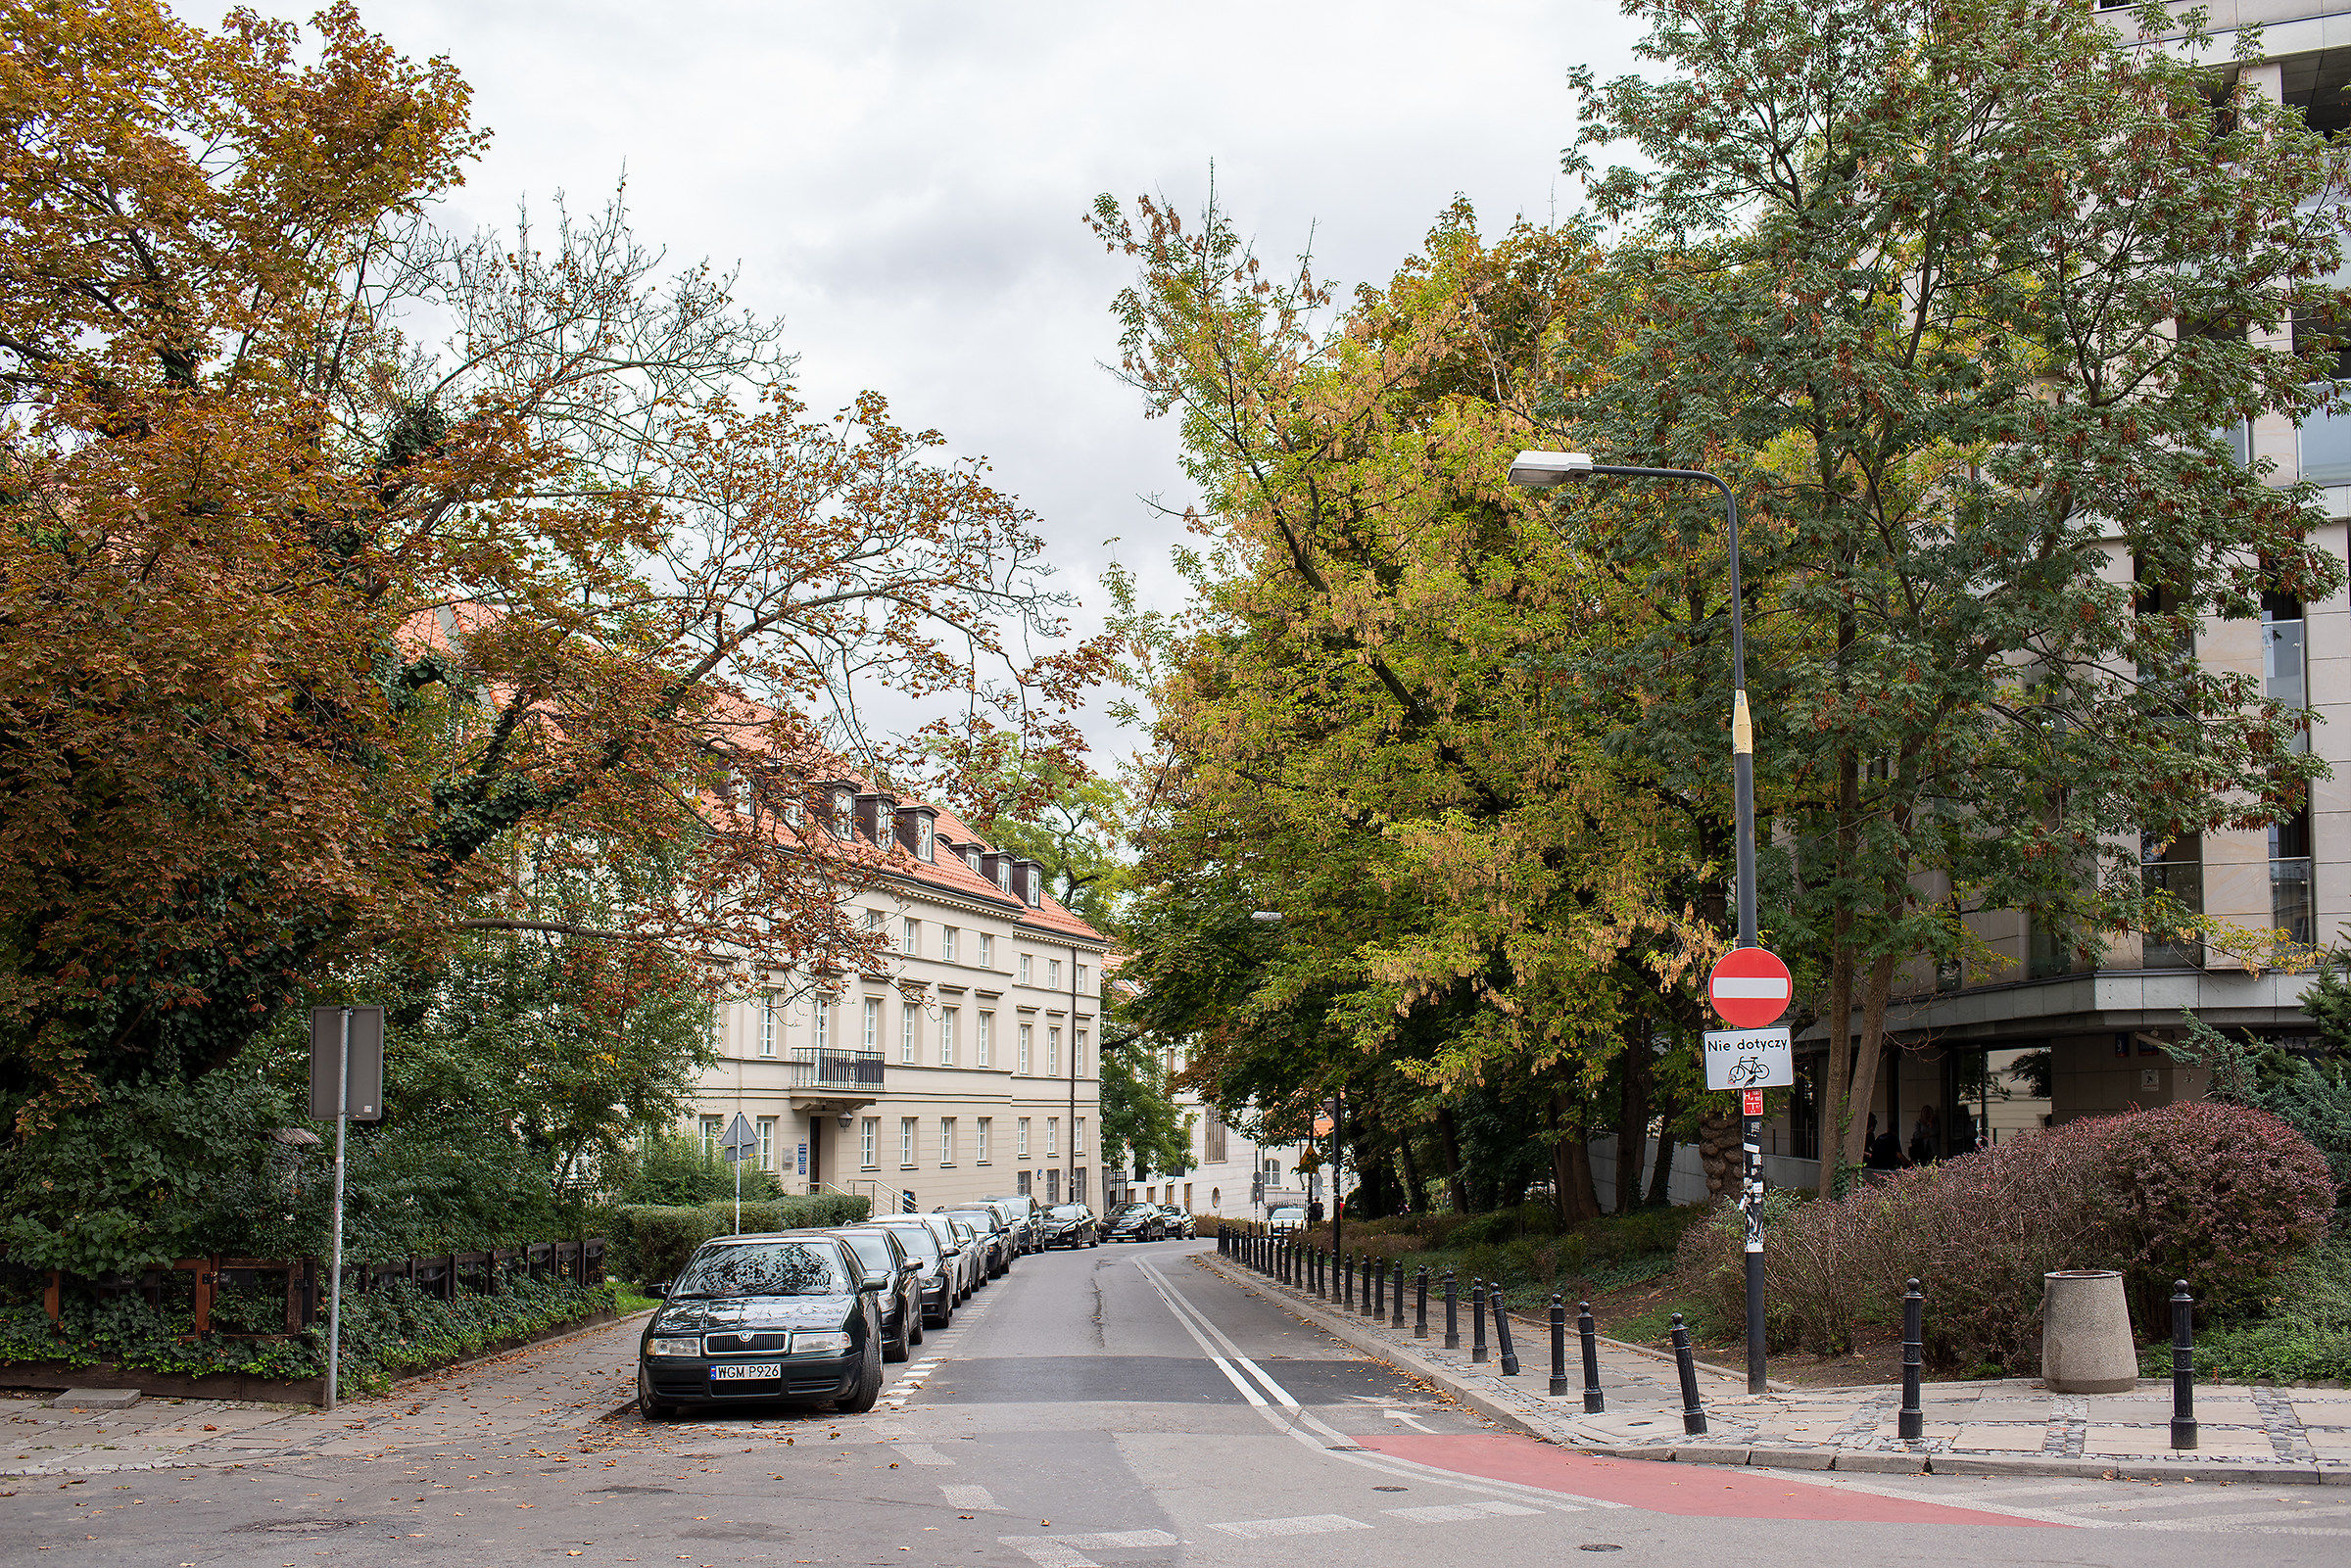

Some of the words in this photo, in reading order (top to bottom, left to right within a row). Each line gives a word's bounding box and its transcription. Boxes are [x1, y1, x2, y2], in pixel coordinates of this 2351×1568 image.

[1707, 1040, 1731, 1052] Nie
[1737, 1038, 1788, 1052] dotyczy
[718, 1366, 744, 1378] WGM
[748, 1365, 779, 1378] P926
